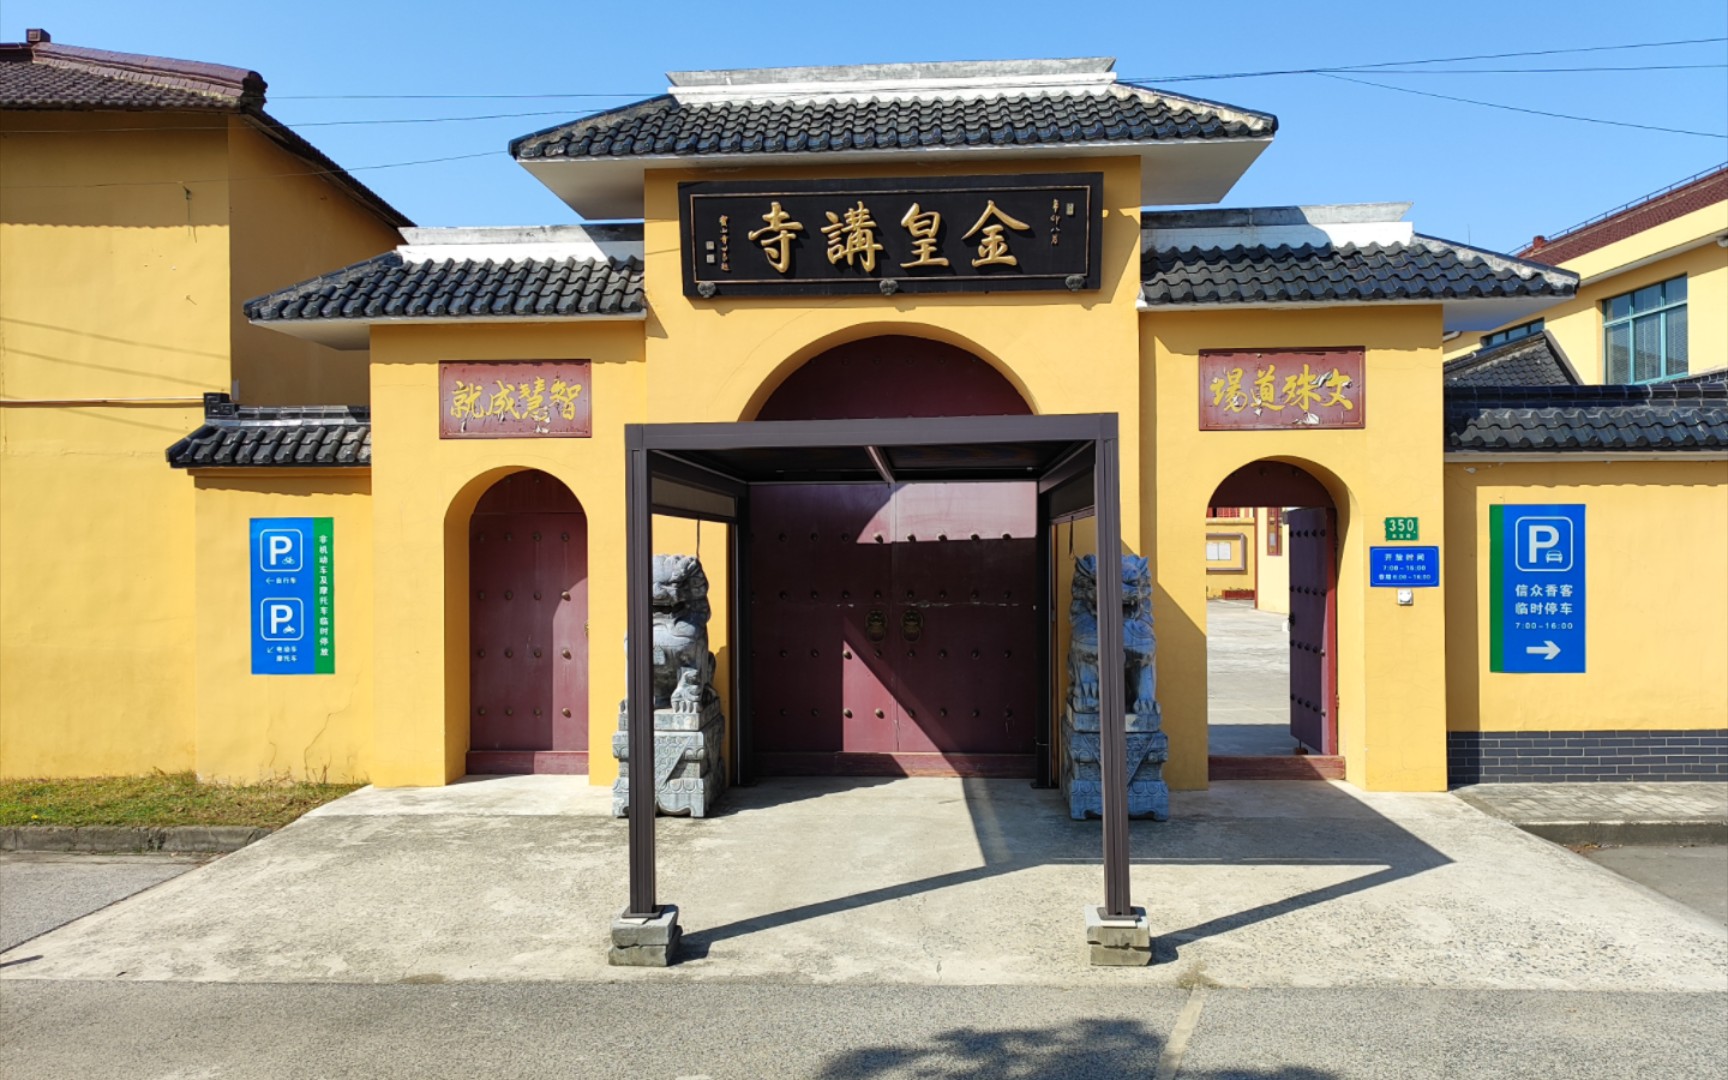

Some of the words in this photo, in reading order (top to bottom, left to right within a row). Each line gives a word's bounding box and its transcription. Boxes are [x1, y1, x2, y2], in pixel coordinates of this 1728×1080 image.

[748, 199, 1031, 274] 金皇講寺
[450, 376, 582, 420] 智慧成就
[1210, 363, 1354, 413] 文殊道場
[1389, 519, 1414, 532] 350
[269, 535, 293, 566] P
[1384, 553, 1425, 562] 开放时间
[1528, 525, 1560, 564] P
[318, 534, 329, 656] 非机动车及摩托车临时停放
[1515, 583, 1574, 598] 信众香客
[270, 604, 294, 635] P
[1515, 602, 1573, 616] 临时停车
